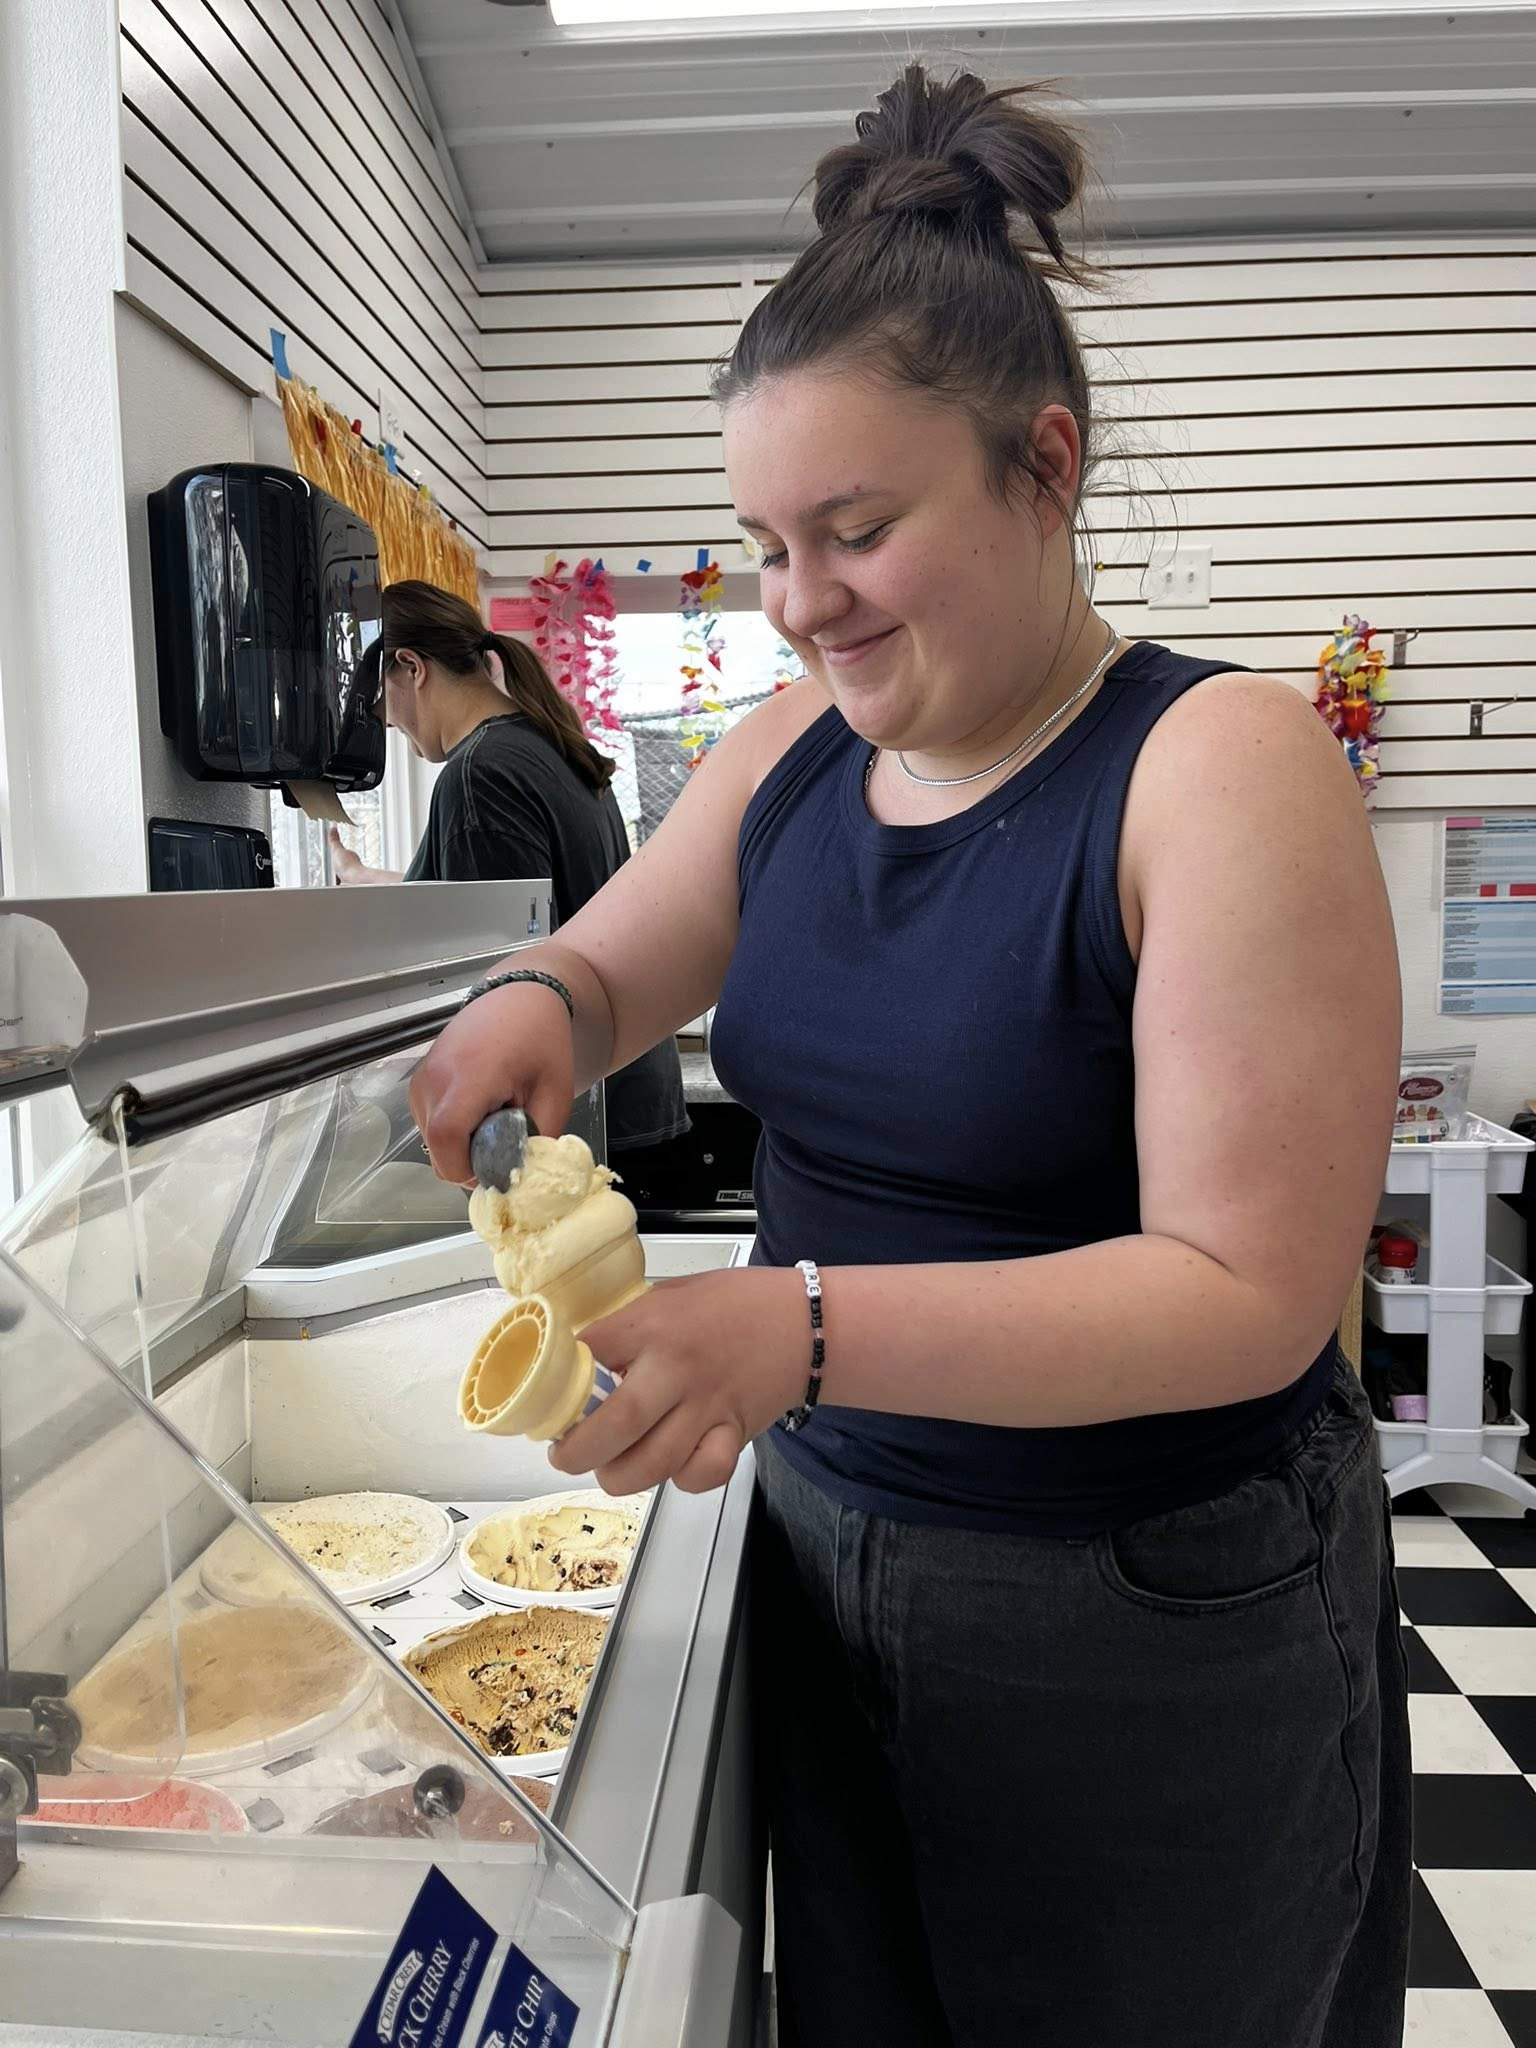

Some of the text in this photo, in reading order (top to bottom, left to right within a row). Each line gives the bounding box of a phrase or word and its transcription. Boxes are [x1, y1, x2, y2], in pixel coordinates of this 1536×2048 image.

[462, 1937, 480, 1971] Cherries
[409, 1939, 452, 2023] CHERRY
[453, 1968, 468, 1992] Black
[381, 1988, 400, 2031] CEDAR
[448, 1990, 459, 2010] with
[516, 1975, 543, 2029] CHIP
[437, 2008, 453, 2036] Cream
[544, 2011, 558, 2036] Chips
